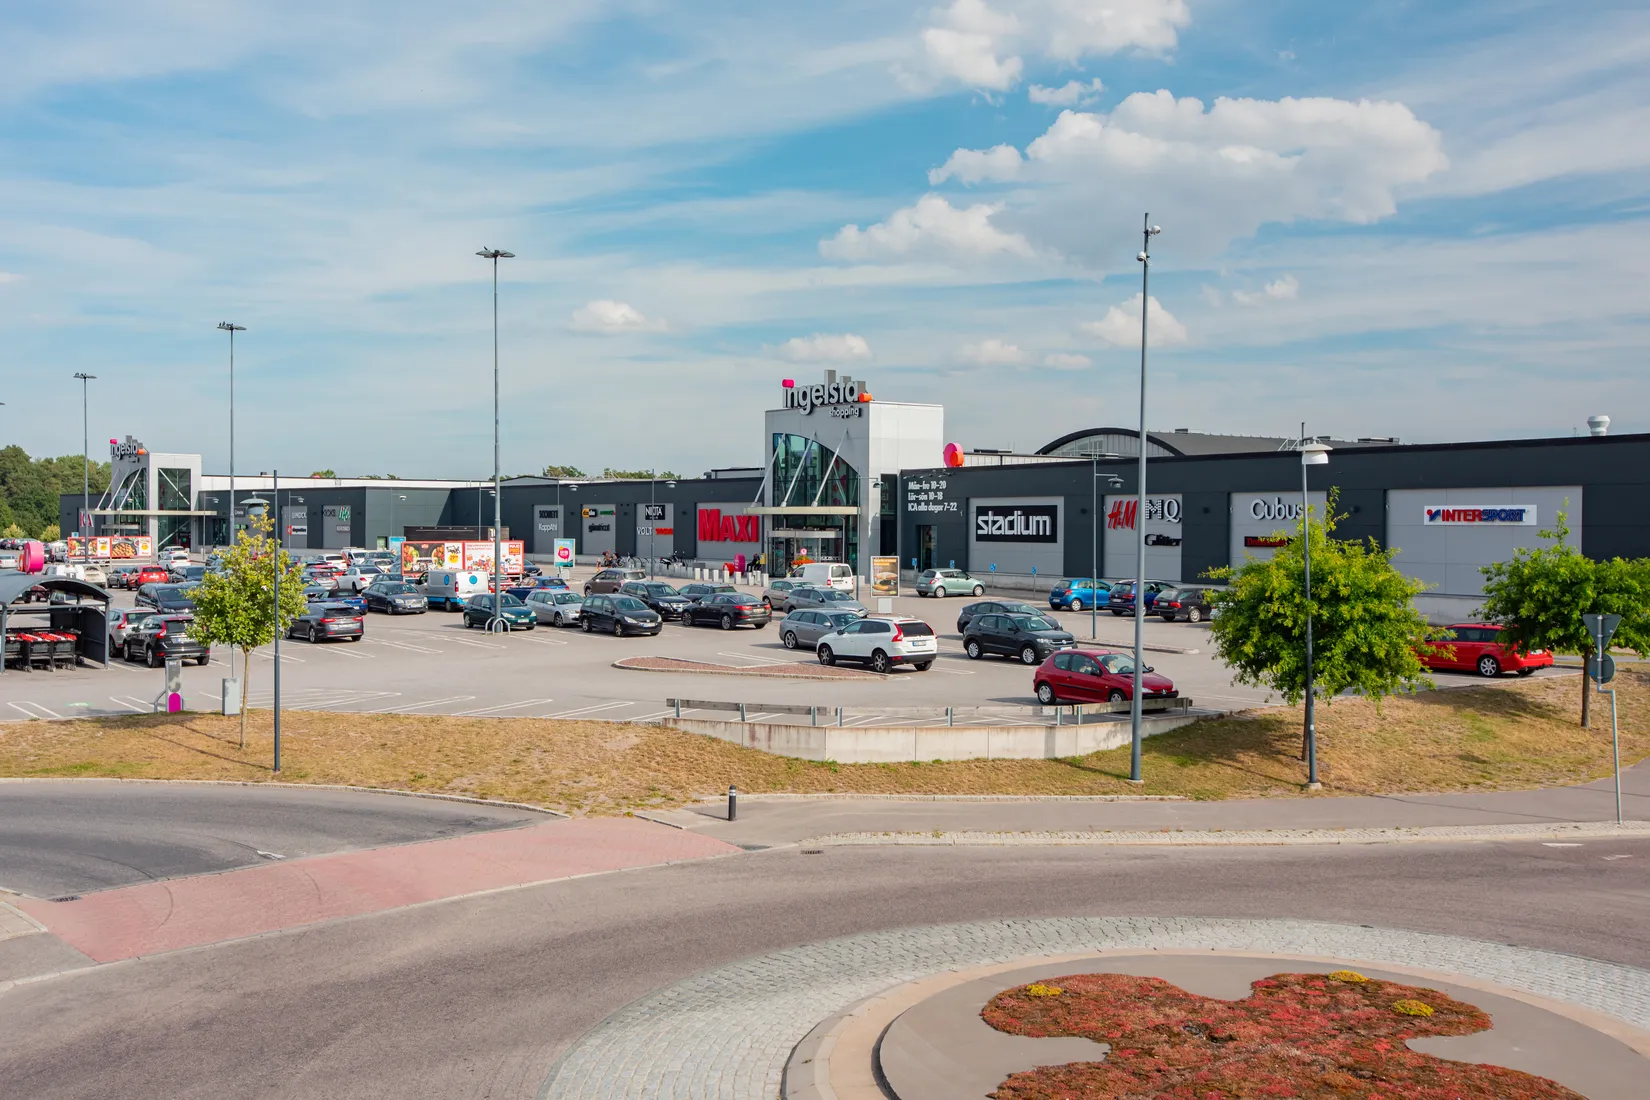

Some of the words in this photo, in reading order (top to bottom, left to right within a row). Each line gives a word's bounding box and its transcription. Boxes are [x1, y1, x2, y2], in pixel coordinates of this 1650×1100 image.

[782, 369, 863, 416] ingelsta
[829, 404, 862, 418] shopping
[907, 503, 918, 511] ICA
[918, 502, 928, 511] alla
[943, 502, 958, 511] 7-22
[1107, 500, 1138, 530] H&M
[1145, 499, 1182, 523] MQ
[1251, 496, 1304, 520] Cubus
[1441, 508, 1526, 522] INTERSPORT
[636, 526, 653, 536] VOLT
[698, 508, 760, 542] MAXI
[977, 510, 1052, 536] stadium
